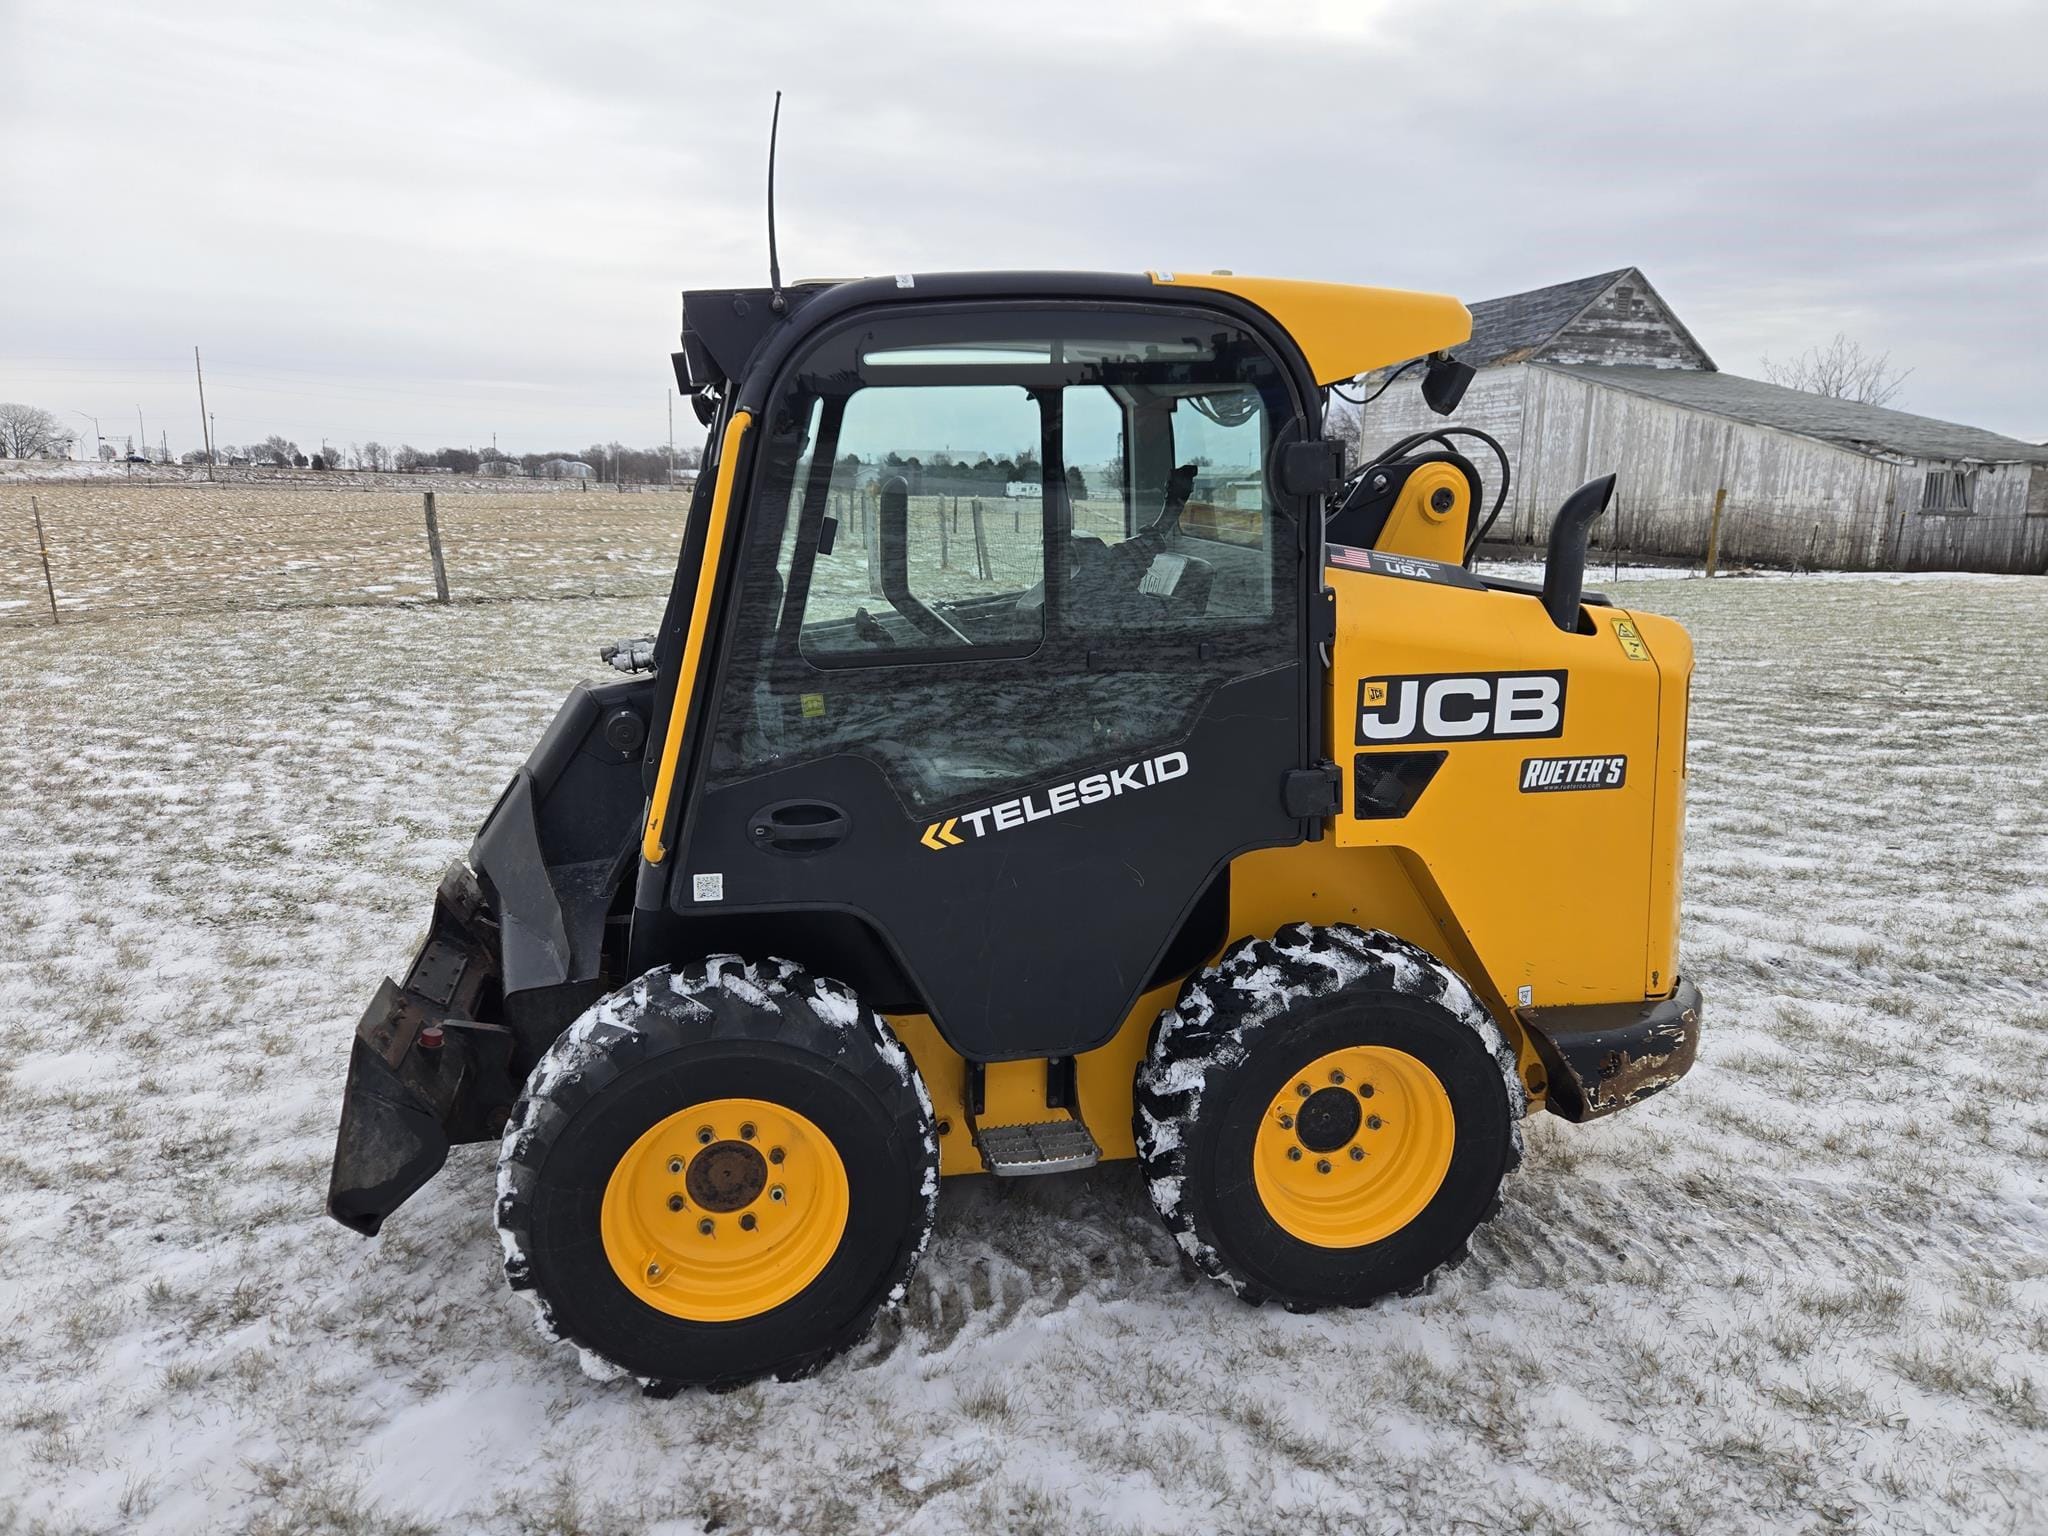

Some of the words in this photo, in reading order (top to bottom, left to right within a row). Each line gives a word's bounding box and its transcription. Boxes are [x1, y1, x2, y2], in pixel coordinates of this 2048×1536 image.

[1385, 562, 1431, 578] USA
[1362, 677, 1560, 739] JCB
[961, 751, 1189, 838] TELESKID
[1522, 758, 1624, 788] RUETER'S
